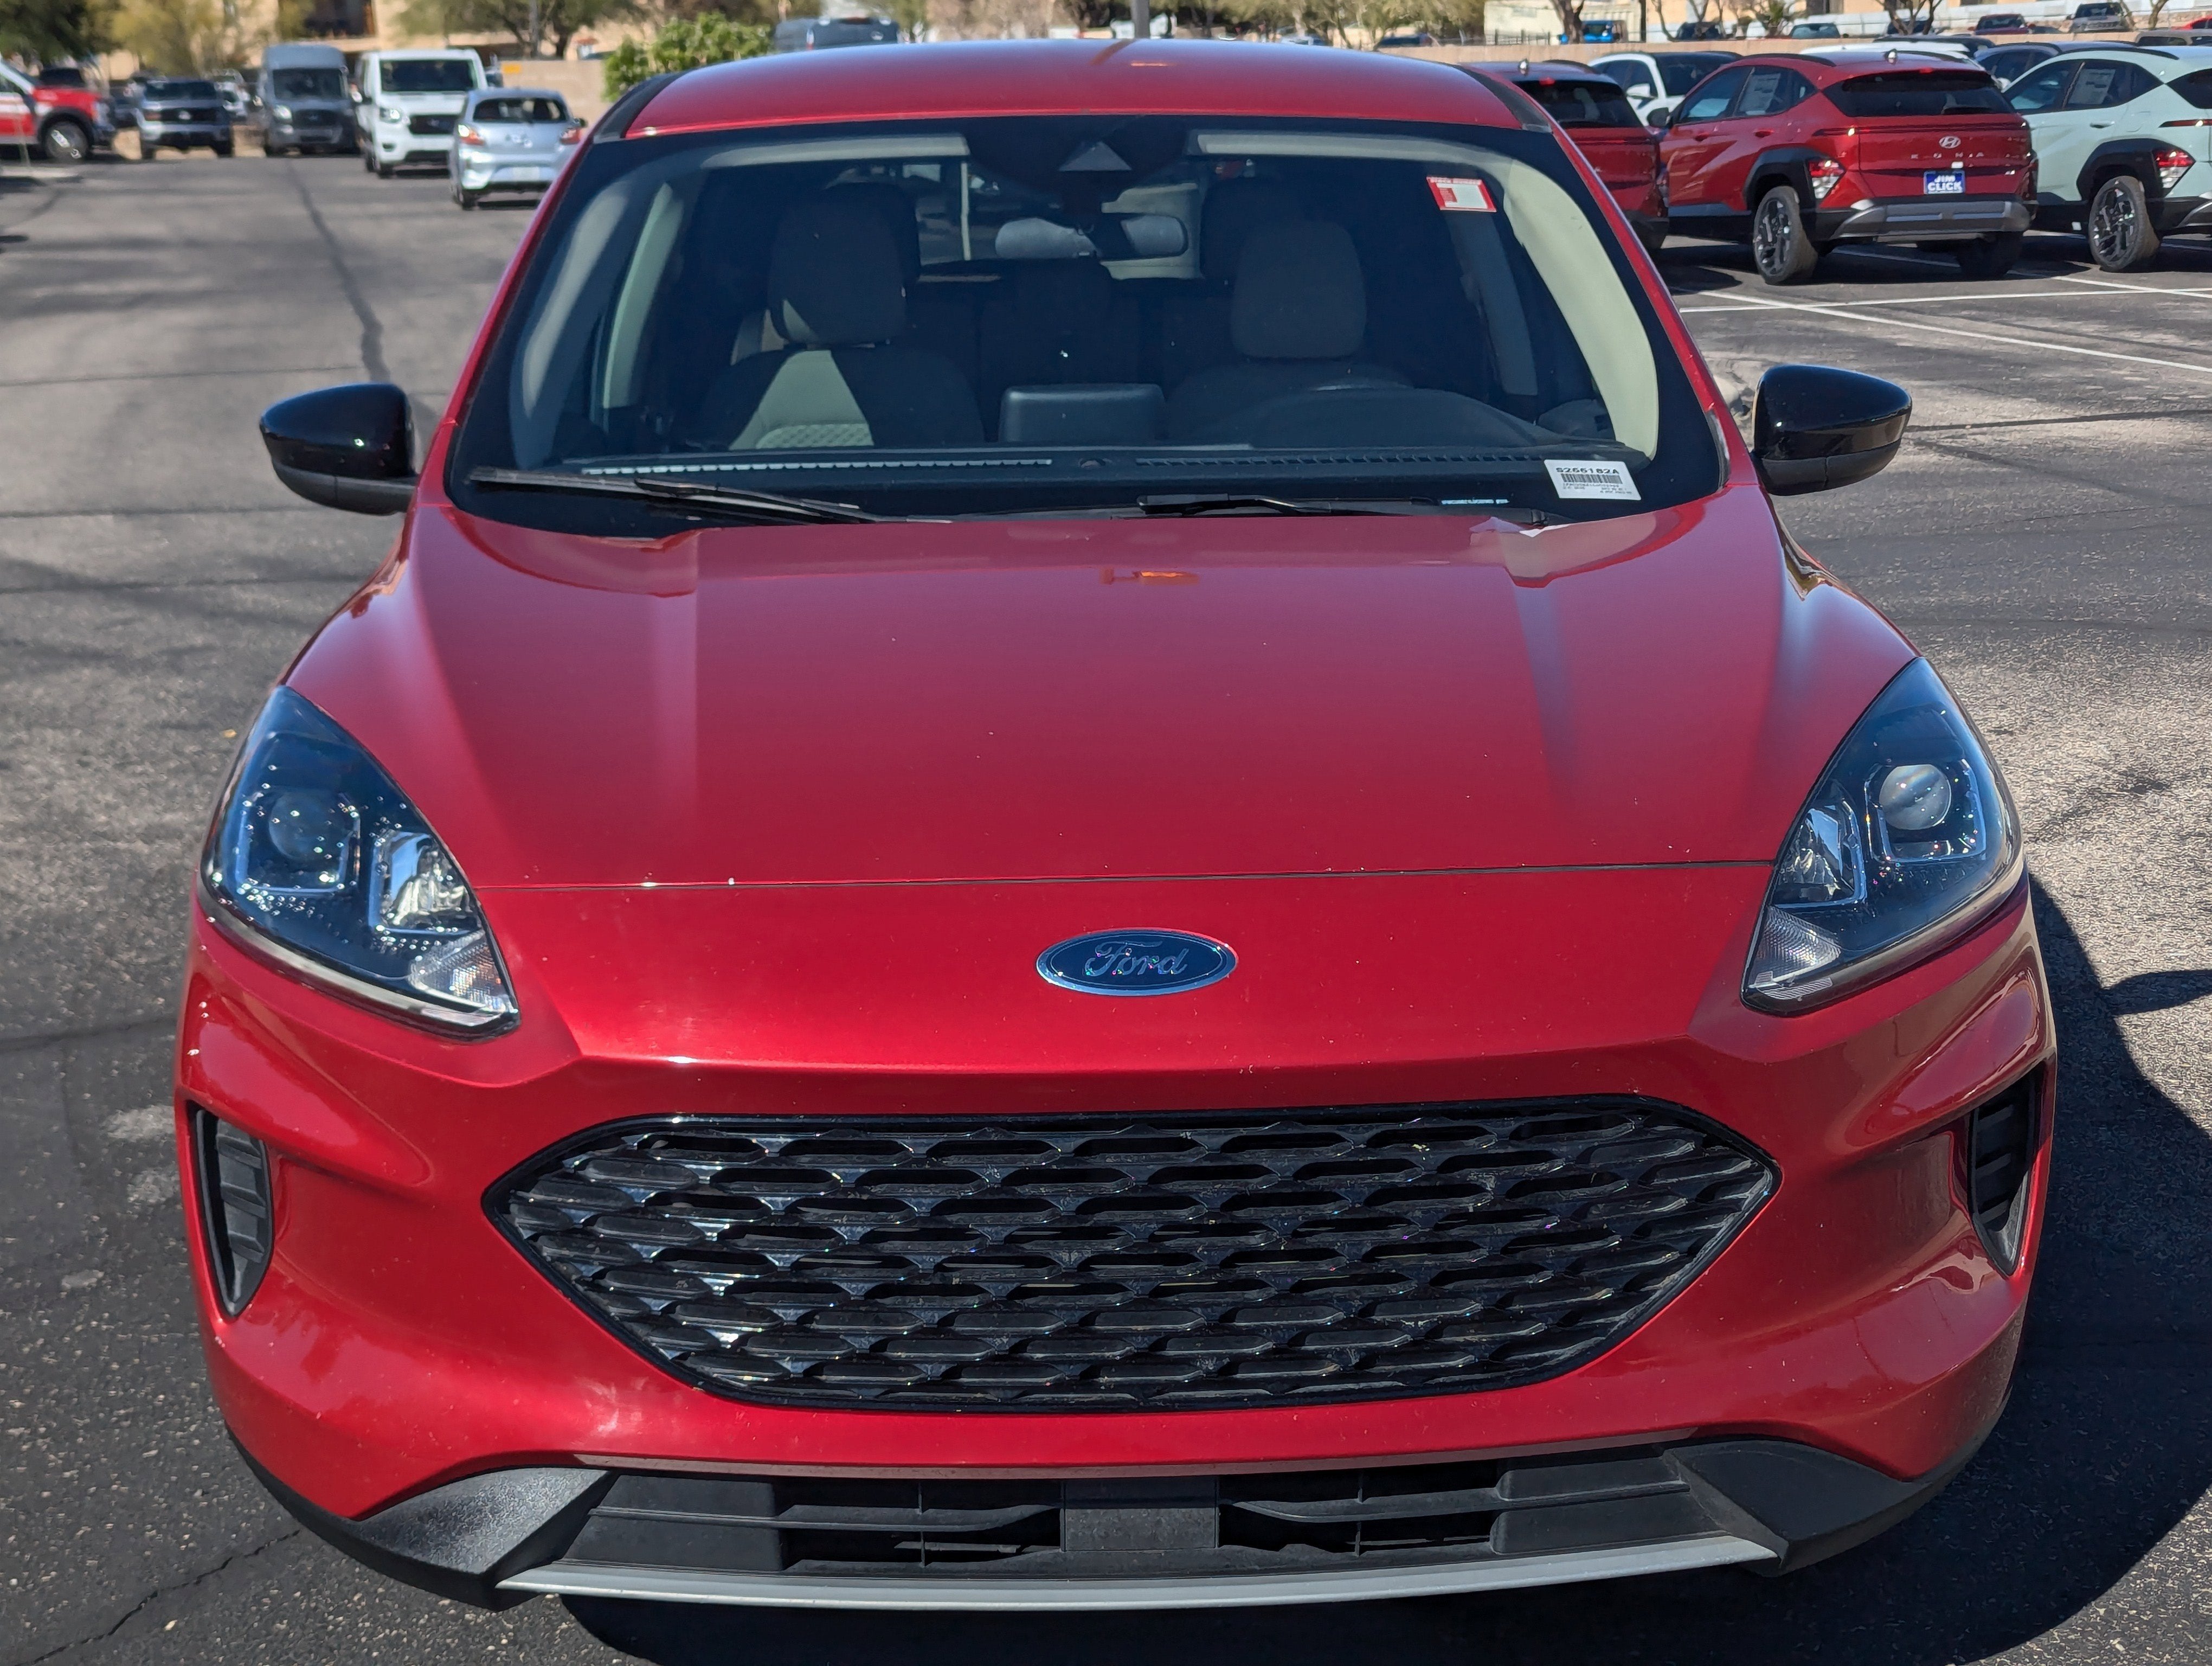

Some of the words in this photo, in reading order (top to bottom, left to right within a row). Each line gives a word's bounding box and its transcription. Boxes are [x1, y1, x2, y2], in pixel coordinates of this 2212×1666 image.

[1934, 175, 1956, 183] JIM
[1927, 182, 1963, 191] CLICK
[1084, 940, 1189, 976] Ford
